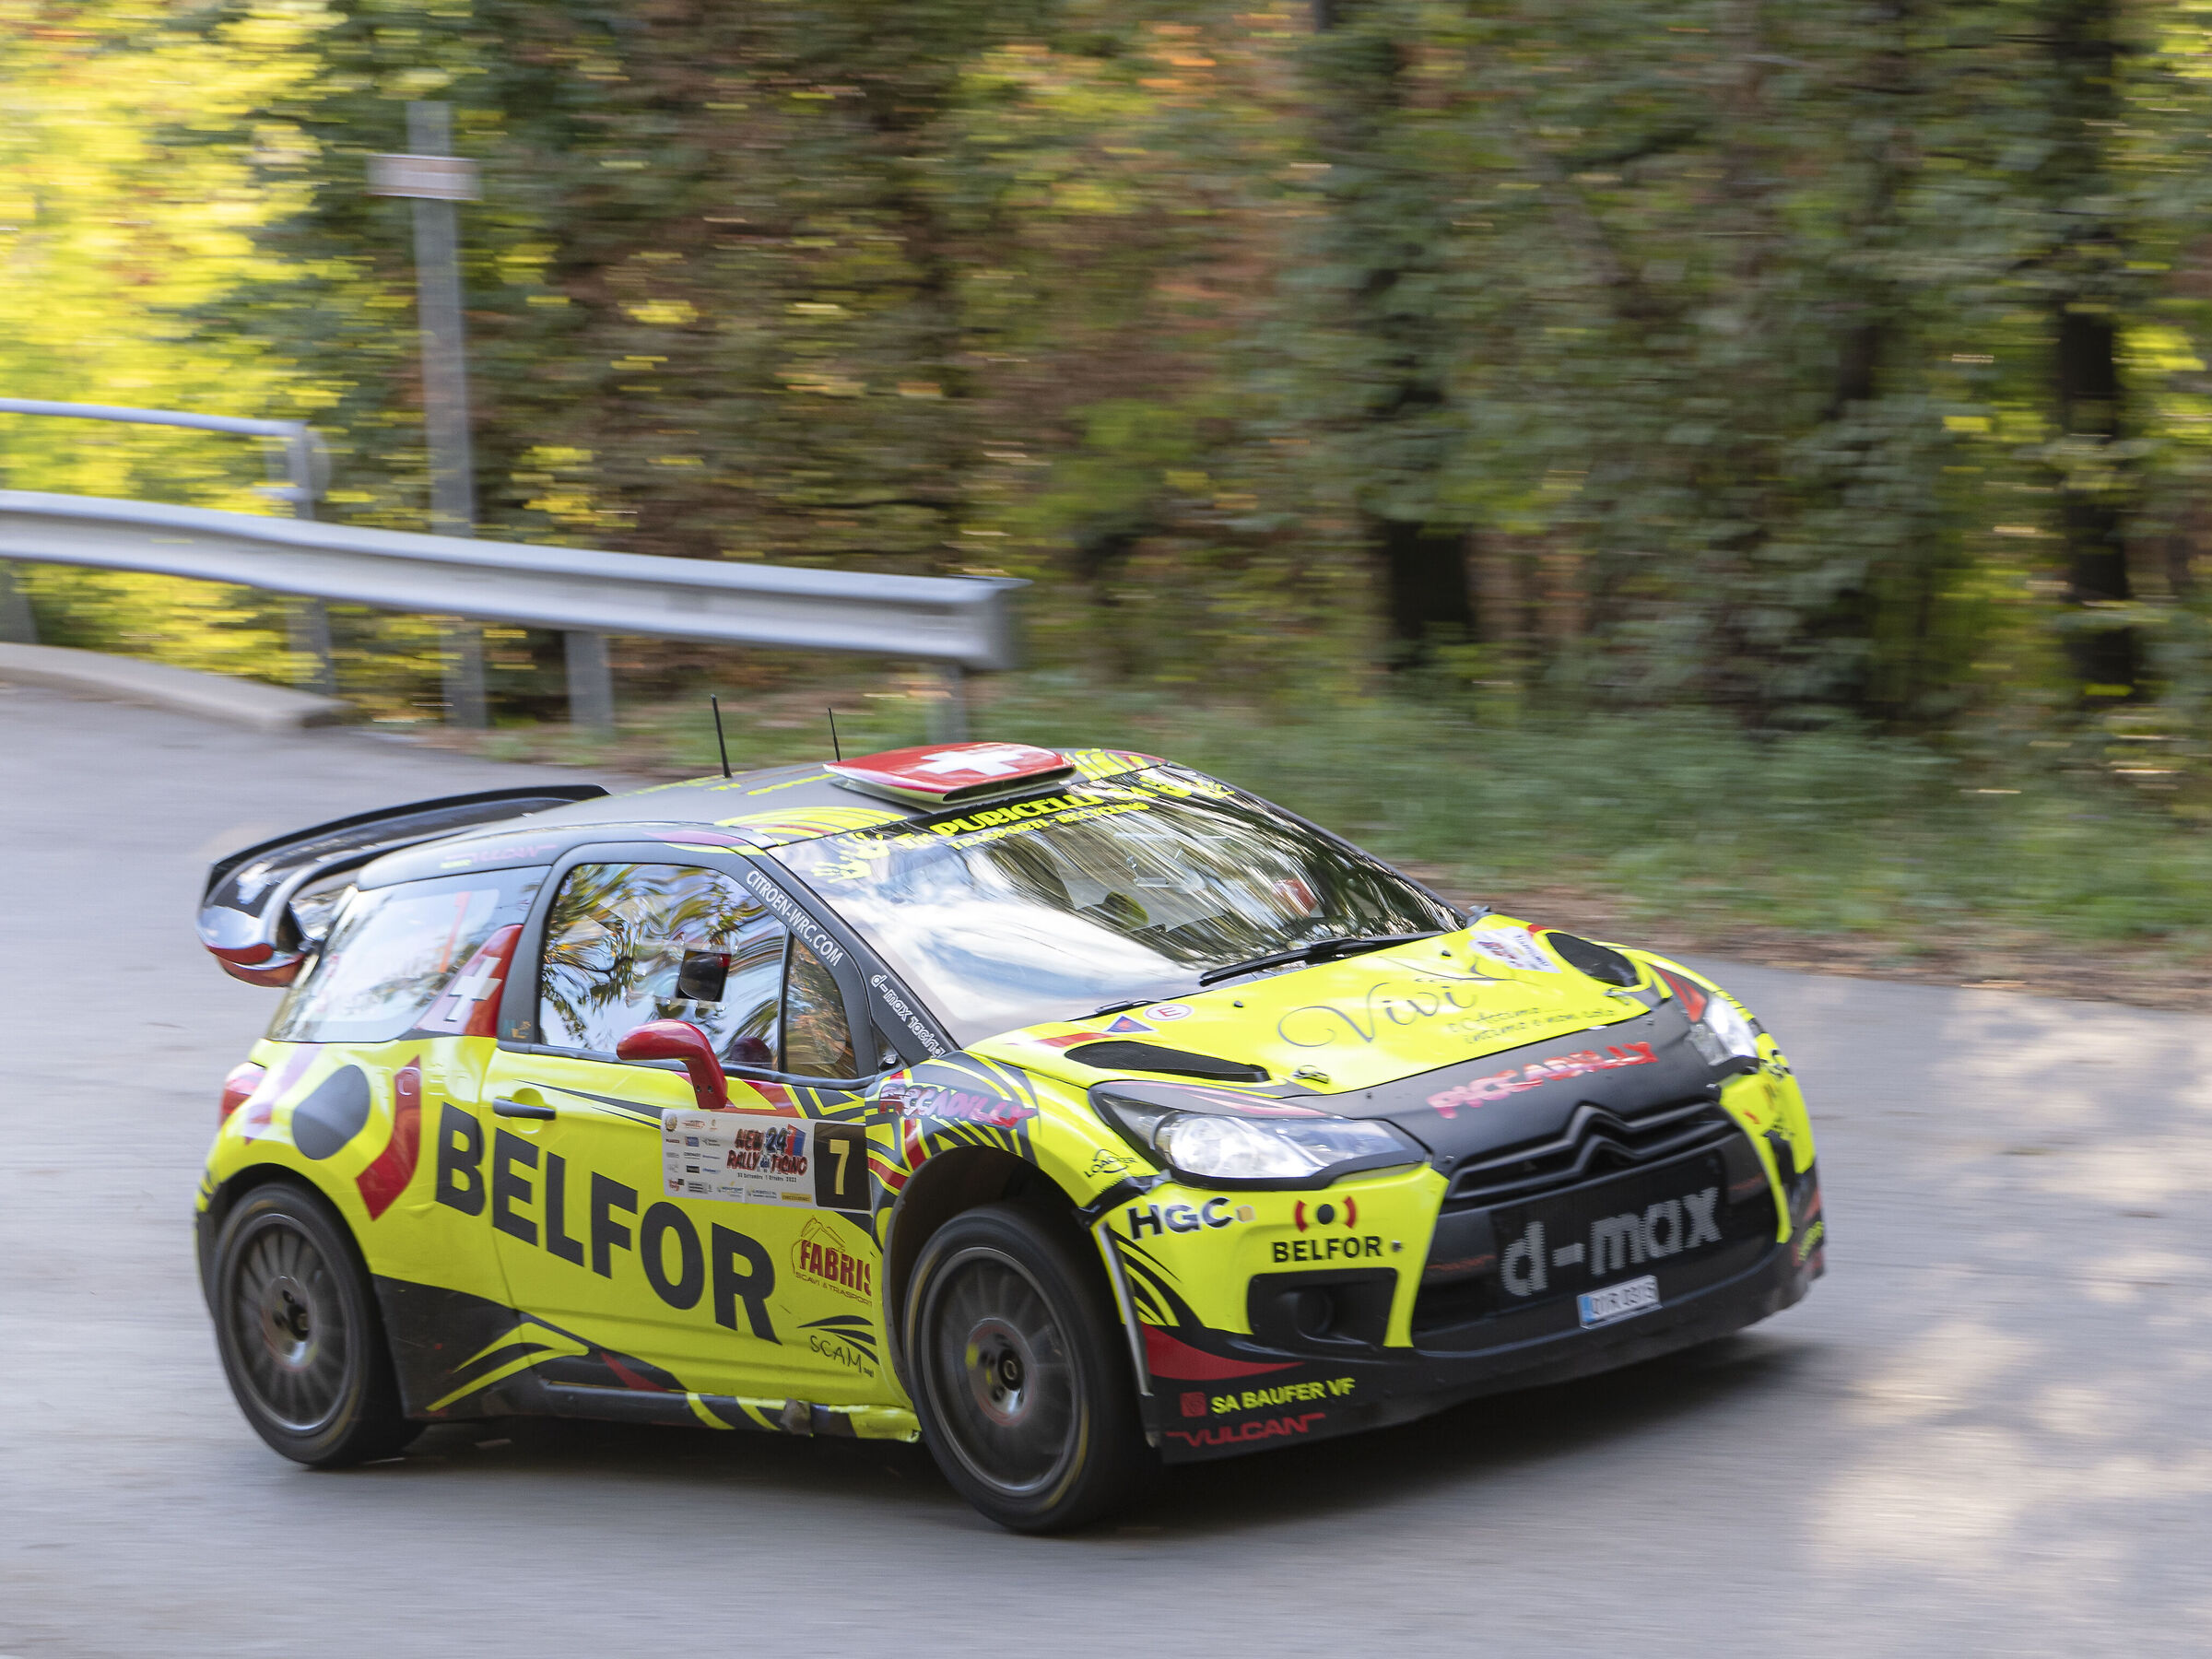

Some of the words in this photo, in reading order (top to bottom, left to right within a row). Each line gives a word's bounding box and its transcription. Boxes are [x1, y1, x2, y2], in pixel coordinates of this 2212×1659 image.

[929, 794, 1105, 838] PURICELLI
[947, 818, 1050, 851] TRASPORTI
[746, 870, 844, 967] CITROEN-WRC.COM
[870, 973, 913, 1023] d-max
[726, 1148, 760, 1171] RALLY
[829, 1138, 851, 1195] 7
[435, 1100, 783, 1347] BELFOR
[1126, 1196, 1234, 1241] HGC
[1270, 1235, 1383, 1264] BELFOR
[1500, 1186, 1723, 1298] d-max
[800, 1239, 872, 1298] FABRIS
[810, 1335, 862, 1373] SCAM
[1210, 1394, 1242, 1415] SA
[1241, 1382, 1327, 1409] BAUFER
[1325, 1377, 1356, 1396] VF
[1165, 1412, 1326, 1448] VULCAN
